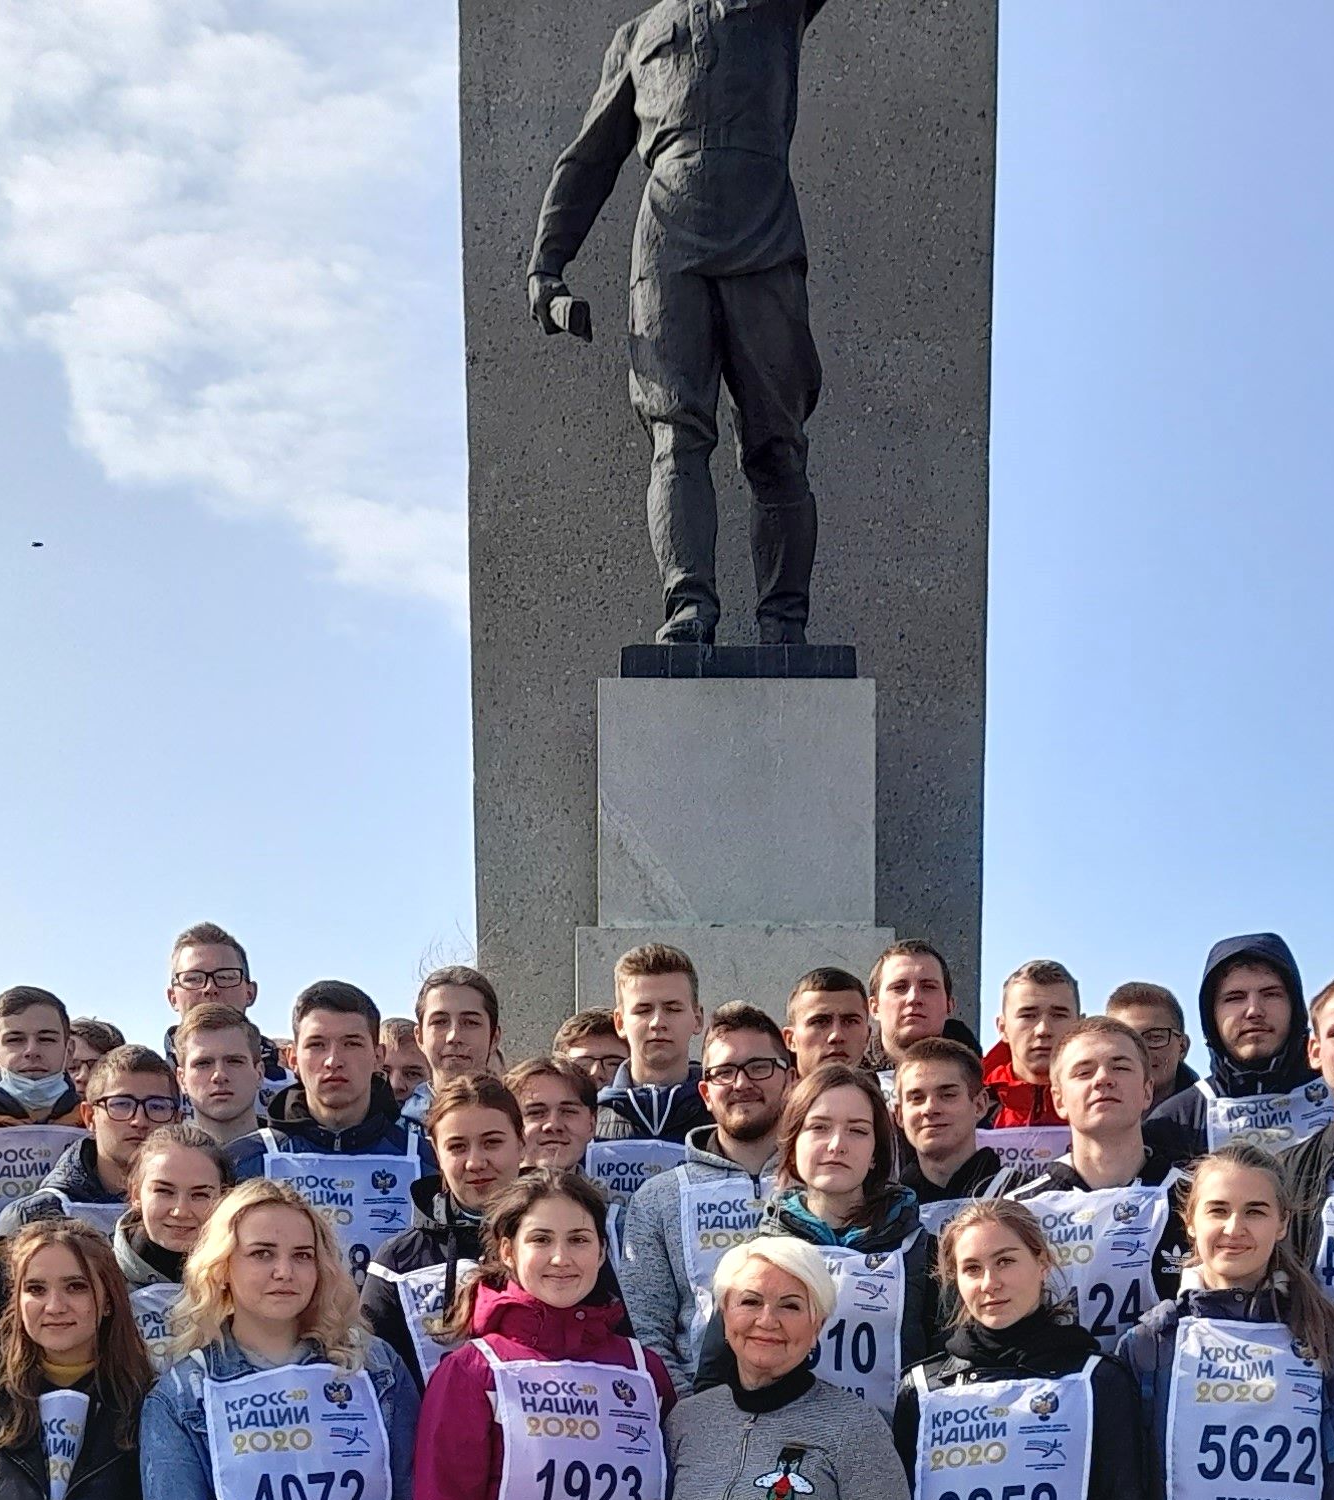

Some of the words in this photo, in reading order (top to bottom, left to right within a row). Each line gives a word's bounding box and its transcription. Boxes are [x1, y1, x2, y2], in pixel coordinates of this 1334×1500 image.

[996, 1147, 1035, 1161] РОСС
[597, 1162, 644, 1177] КРОСС
[696, 1199, 747, 1216] КРОСС
[1200, 1344, 1252, 1363] КРОСС
[1196, 1359, 1275, 1381] НАЦИИ
[518, 1380, 579, 1396] КРОСС
[1195, 1381, 1276, 1403] 2020
[224, 1390, 287, 1414] КРОСС
[520, 1396, 599, 1416] НАЦИИ
[227, 1406, 310, 1432] НАЦИИ
[526, 1416, 601, 1441] 2020
[932, 1405, 988, 1429] КРОСС
[232, 1428, 312, 1456] 2020
[930, 1421, 1007, 1447] НАЦИИ
[930, 1441, 1006, 1471] 2020
[1197, 1424, 1317, 1486] 5622
